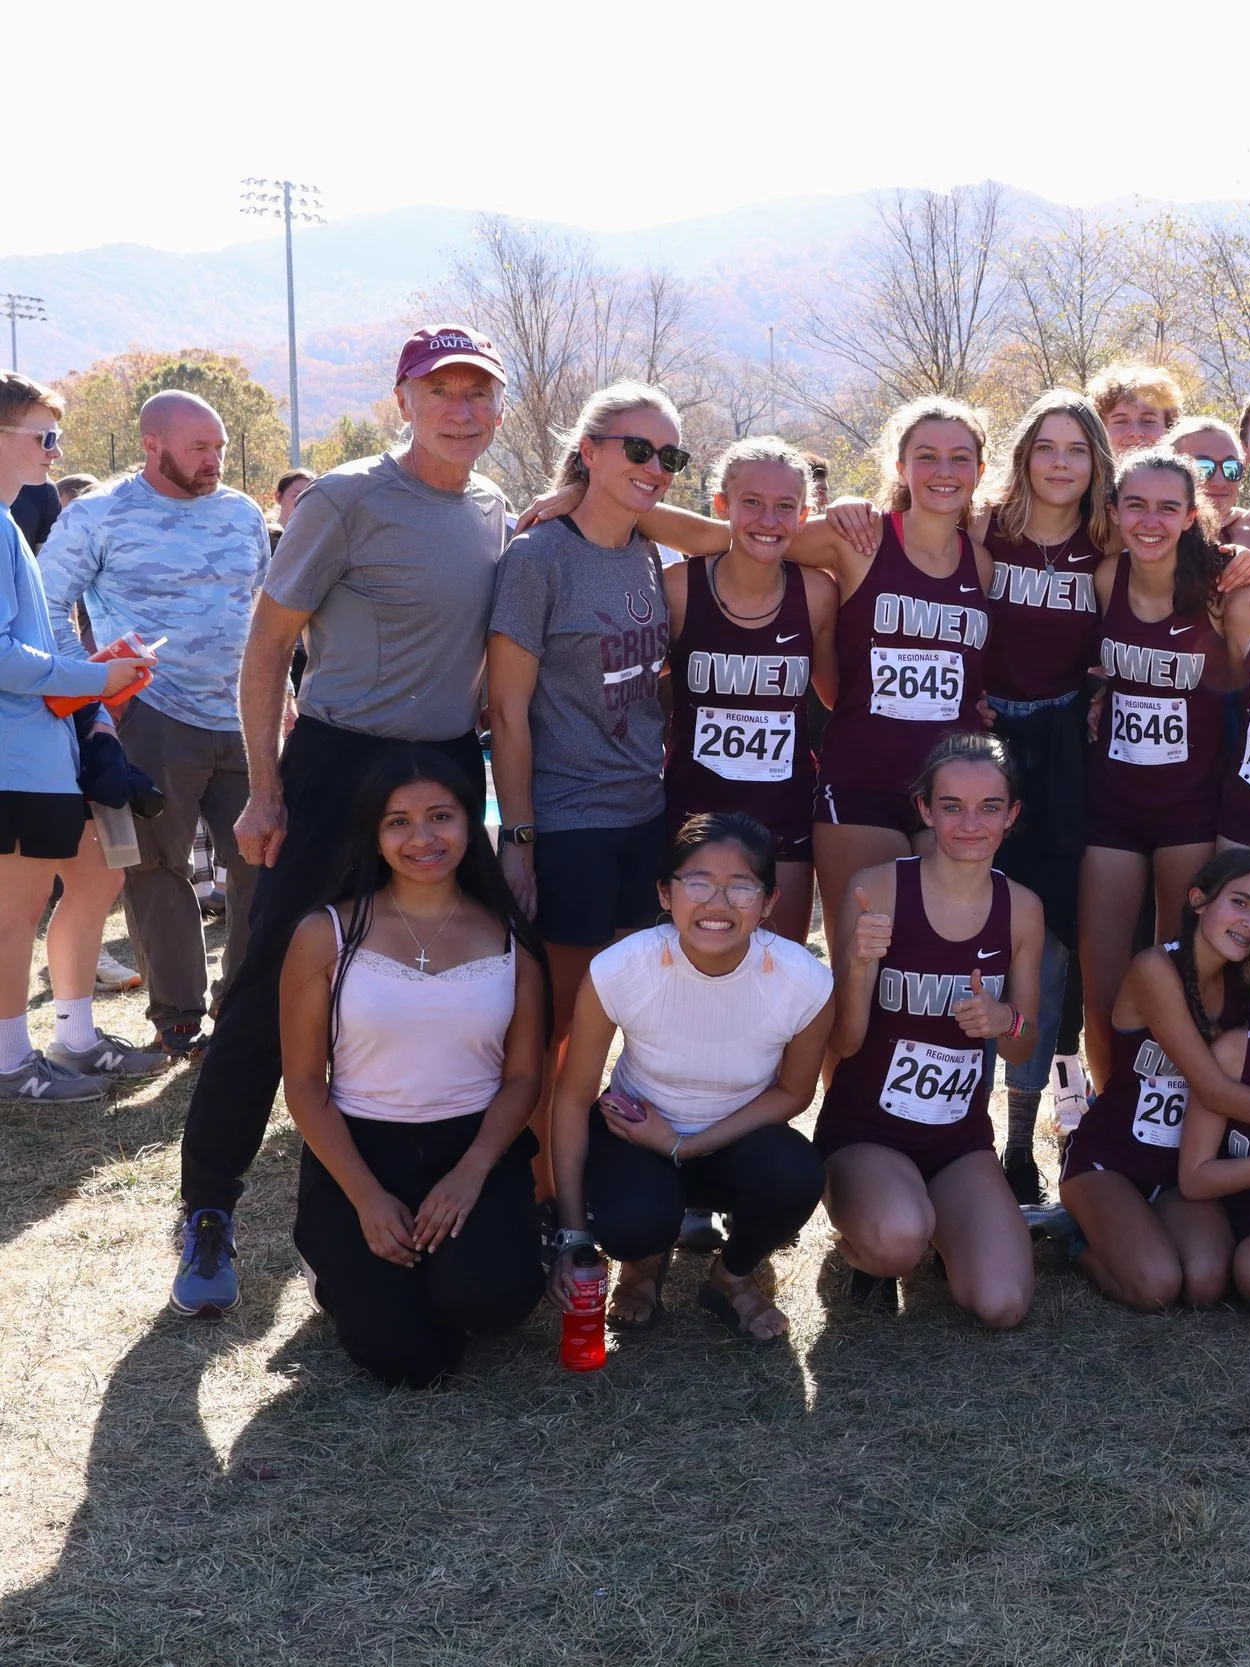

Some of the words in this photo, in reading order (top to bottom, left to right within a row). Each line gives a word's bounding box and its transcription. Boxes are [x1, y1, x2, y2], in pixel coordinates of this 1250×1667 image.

[987, 561, 1097, 614] OWEN
[874, 593, 988, 650] OWEN
[687, 651, 810, 697] OWEN
[898, 653, 939, 662] REGIONALS
[1100, 637, 1206, 691] OWEN
[876, 664, 959, 701] 2645
[726, 713, 769, 724] REGIONALS
[1125, 700, 1162, 711] REGIONALS
[699, 723, 792, 761] 2647
[1113, 708, 1184, 745] 2646
[925, 1048, 966, 1064] REGIONALS
[889, 1056, 977, 1103] 2644
